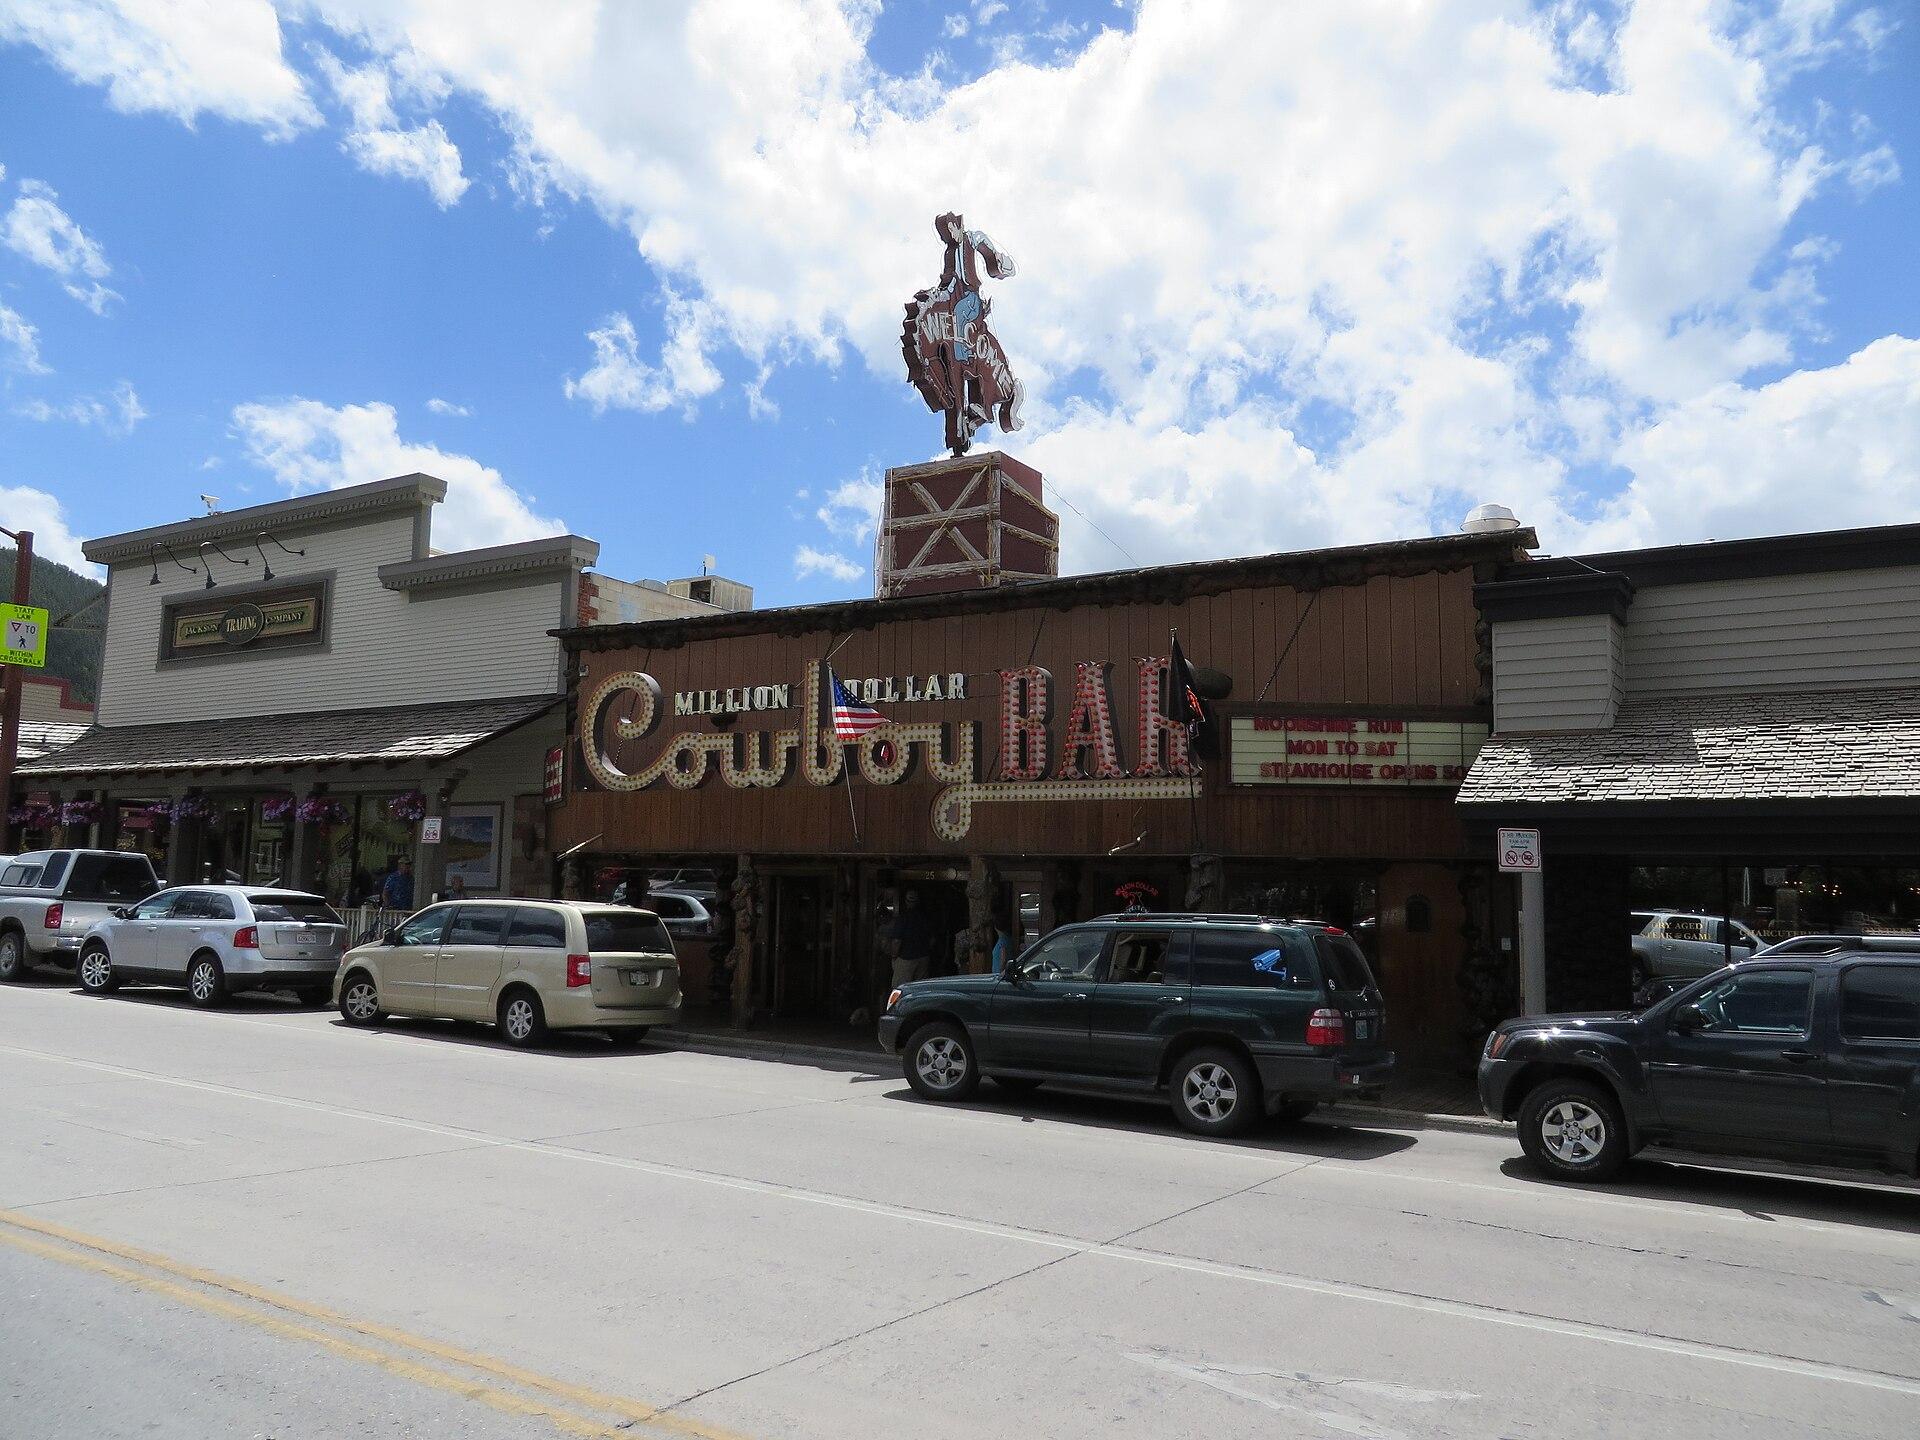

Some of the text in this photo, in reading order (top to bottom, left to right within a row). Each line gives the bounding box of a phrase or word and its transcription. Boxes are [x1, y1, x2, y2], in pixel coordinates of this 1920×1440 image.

[920, 311, 1014, 398] WELCOME
[14, 606, 35, 615] STATE
[25, 624, 36, 634] TO
[185, 611, 304, 636] JACKSON TRADING COMPANY
[0, 655, 42, 665] CROSSWALK
[9, 650, 33, 658] WITHIN
[675, 672, 966, 716] MILLION DOLLAR
[995, 656, 1203, 782] BAR
[1254, 717, 1404, 733] MOONSHINE RUN
[582, 658, 1202, 842] Cowboy
[1287, 740, 1398, 756] MON TO SAT
[1260, 762, 1373, 779] STEAKHOUSE
[1379, 764, 1437, 780] OPENS
[925, 871, 935, 880] 25
[1675, 922, 1703, 930] AGED
